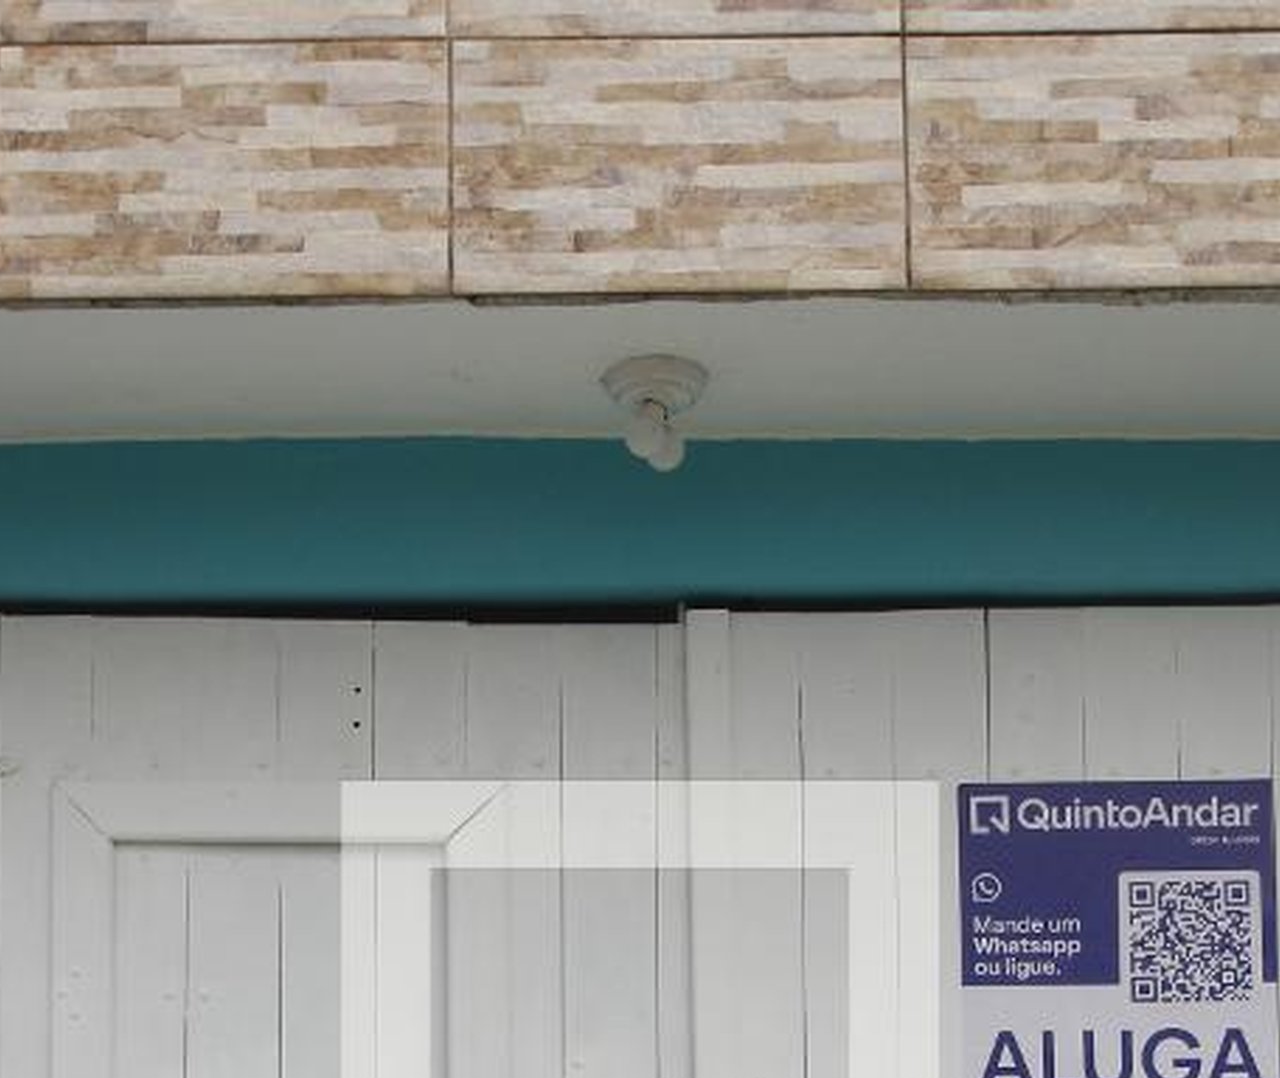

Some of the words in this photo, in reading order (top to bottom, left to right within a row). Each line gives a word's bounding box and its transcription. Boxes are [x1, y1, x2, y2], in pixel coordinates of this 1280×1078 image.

[1017, 797, 1259, 831] QuintoAndar
[973, 916, 1044, 934] Mande
[1048, 918, 1081, 933] um
[973, 937, 1081, 958] Whatsapp
[974, 962, 1000, 976] ou
[1005, 957, 1062, 980] ligue.
